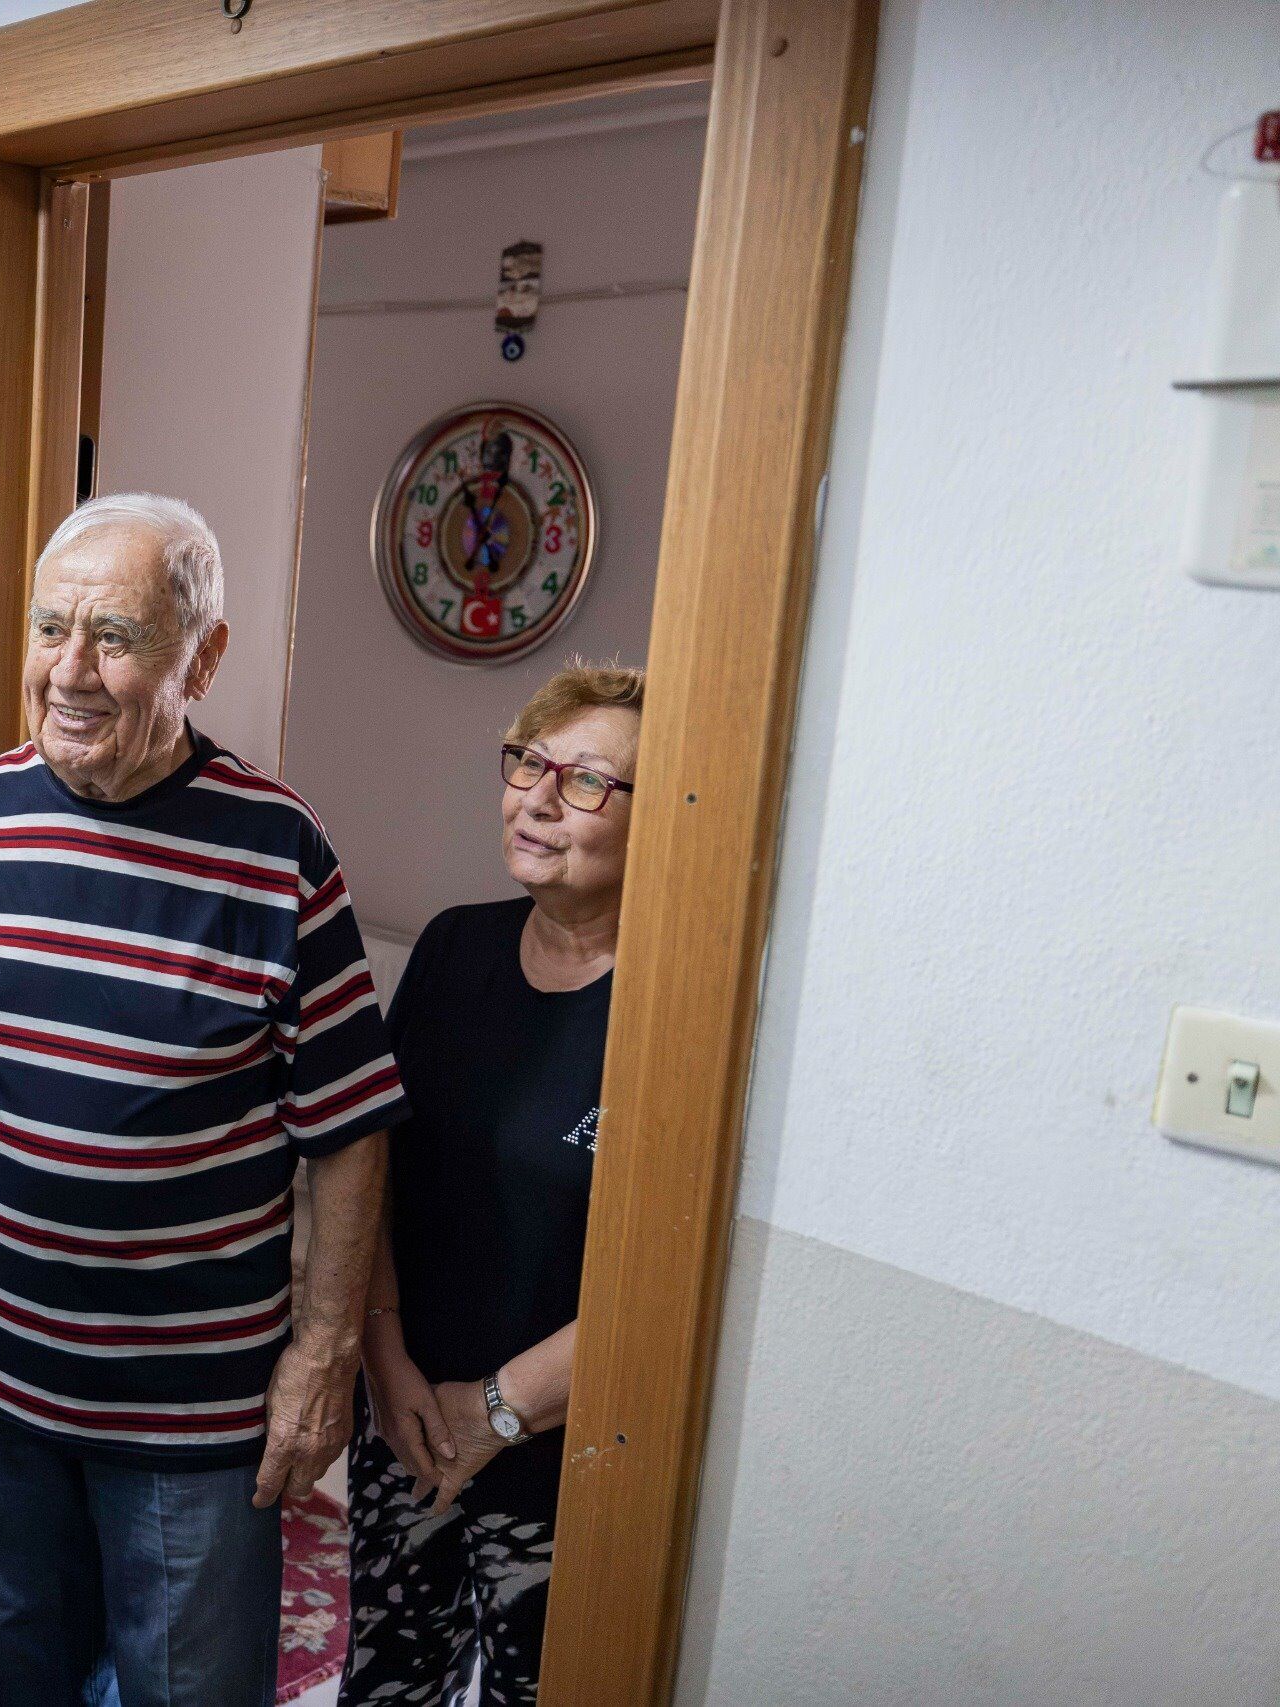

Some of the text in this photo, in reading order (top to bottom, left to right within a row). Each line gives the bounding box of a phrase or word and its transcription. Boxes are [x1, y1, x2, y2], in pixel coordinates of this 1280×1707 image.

[529, 449, 539, 474] 1
[417, 484, 438, 506] 10
[547, 482, 566, 505] 2
[544, 525, 562, 554] 3
[414, 562, 429, 586] 8
[542, 571, 559, 596] 4
[439, 599, 454, 621] 7
[511, 604, 527, 628] 5
